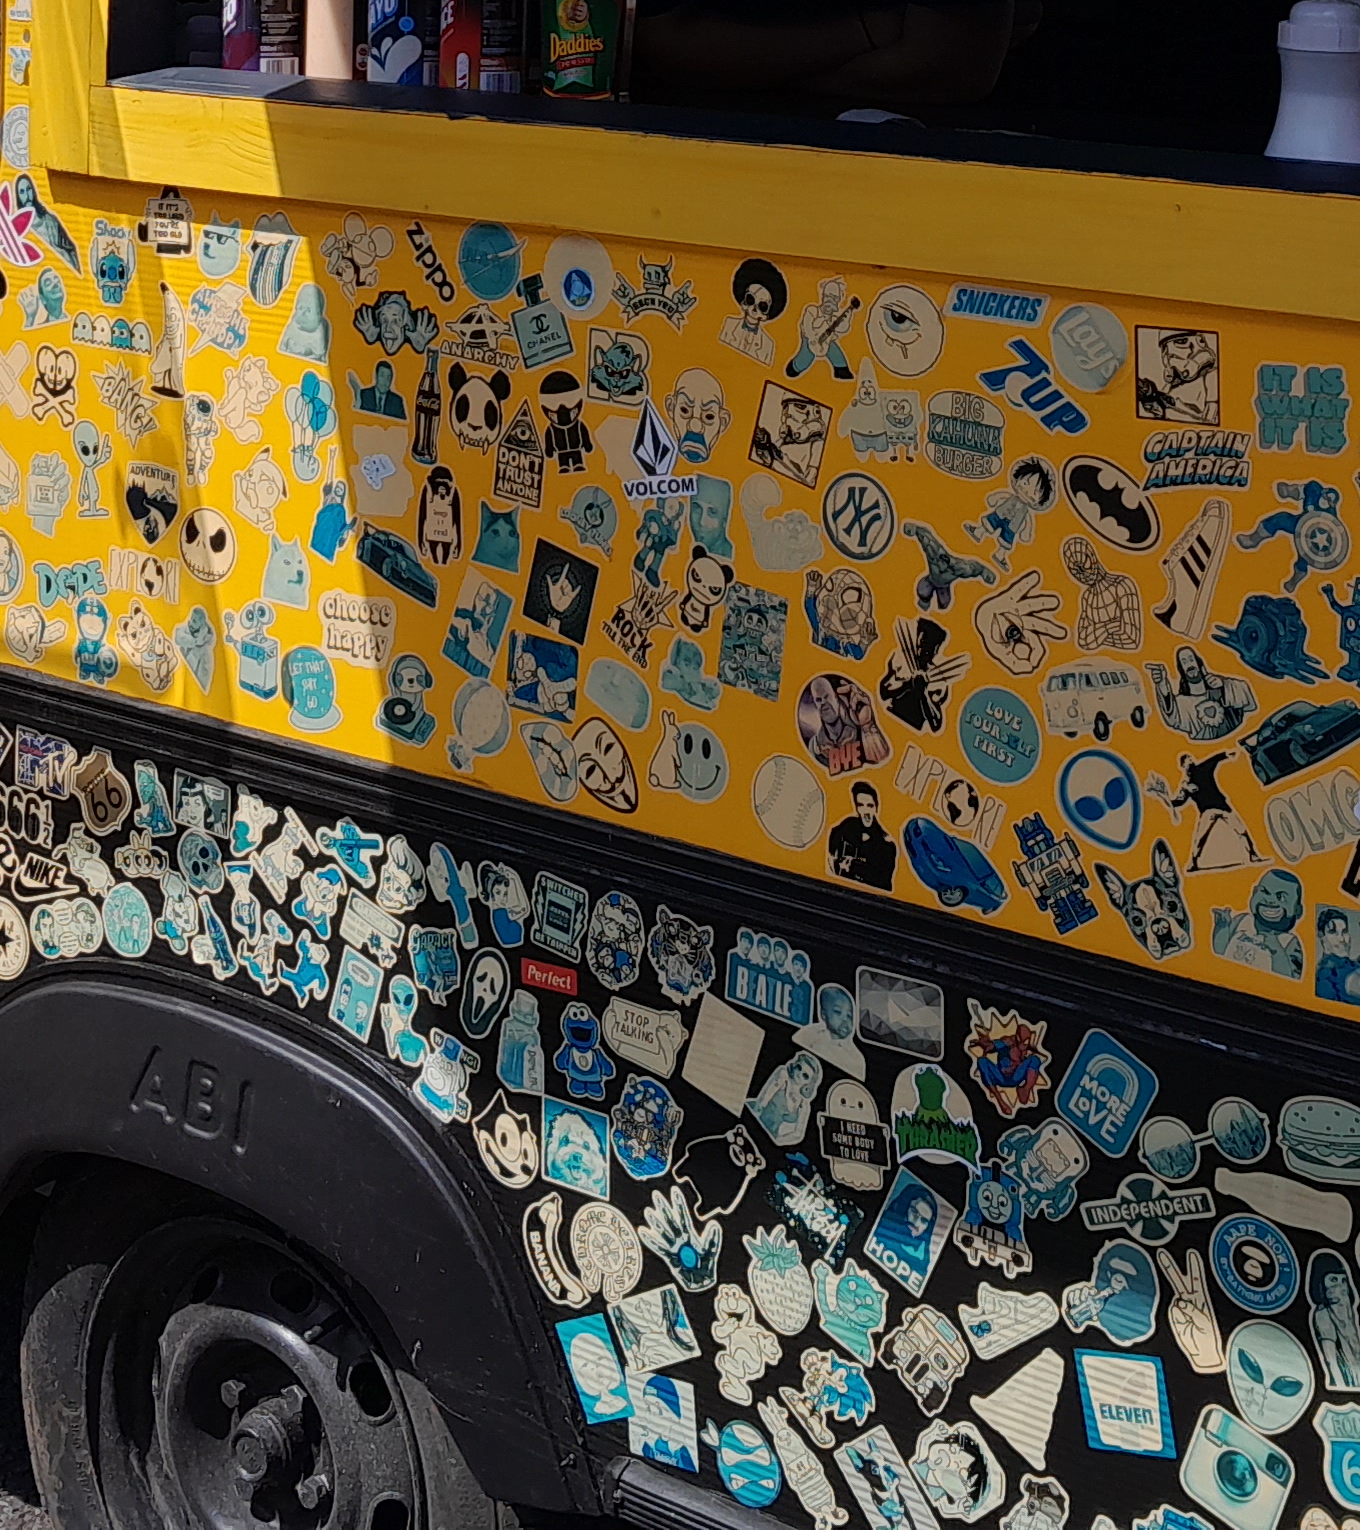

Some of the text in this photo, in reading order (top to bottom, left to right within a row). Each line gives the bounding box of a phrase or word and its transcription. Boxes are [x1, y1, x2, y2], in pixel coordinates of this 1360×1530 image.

[549, 33, 605, 63] Daddies
[952, 289, 1042, 322] SNICKERS
[441, 340, 520, 369] ANARCHY
[951, 393, 985, 421] BIG
[928, 414, 1002, 454] KAHUNA
[1142, 421, 1250, 462] CAPTAIN
[499, 449, 541, 471] DON'T
[934, 443, 993, 475] BURGER
[1143, 459, 1250, 488] AMERICA
[496, 476, 539, 503] ANYONE
[498, 463, 539, 488] TRUST
[625, 477, 695, 497] VOLCOM
[323, 594, 392, 626] choose
[327, 626, 388, 660] happy
[612, 608, 652, 659] ROCK
[985, 702, 1023, 732] LOVE
[829, 744, 861, 775] BYE
[974, 737, 1016, 767] FIRST
[24, 855, 66, 886] NIKE
[527, 965, 572, 990] Perfect
[131, 1045, 253, 1154] ABI
[1080, 1073, 1131, 1119] MORE
[1073, 1096, 1122, 1145] LOVE
[1090, 1195, 1207, 1224] INDEPENDENT
[531, 1230, 561, 1298] BANANA
[870, 1242, 922, 1289] HOPE
